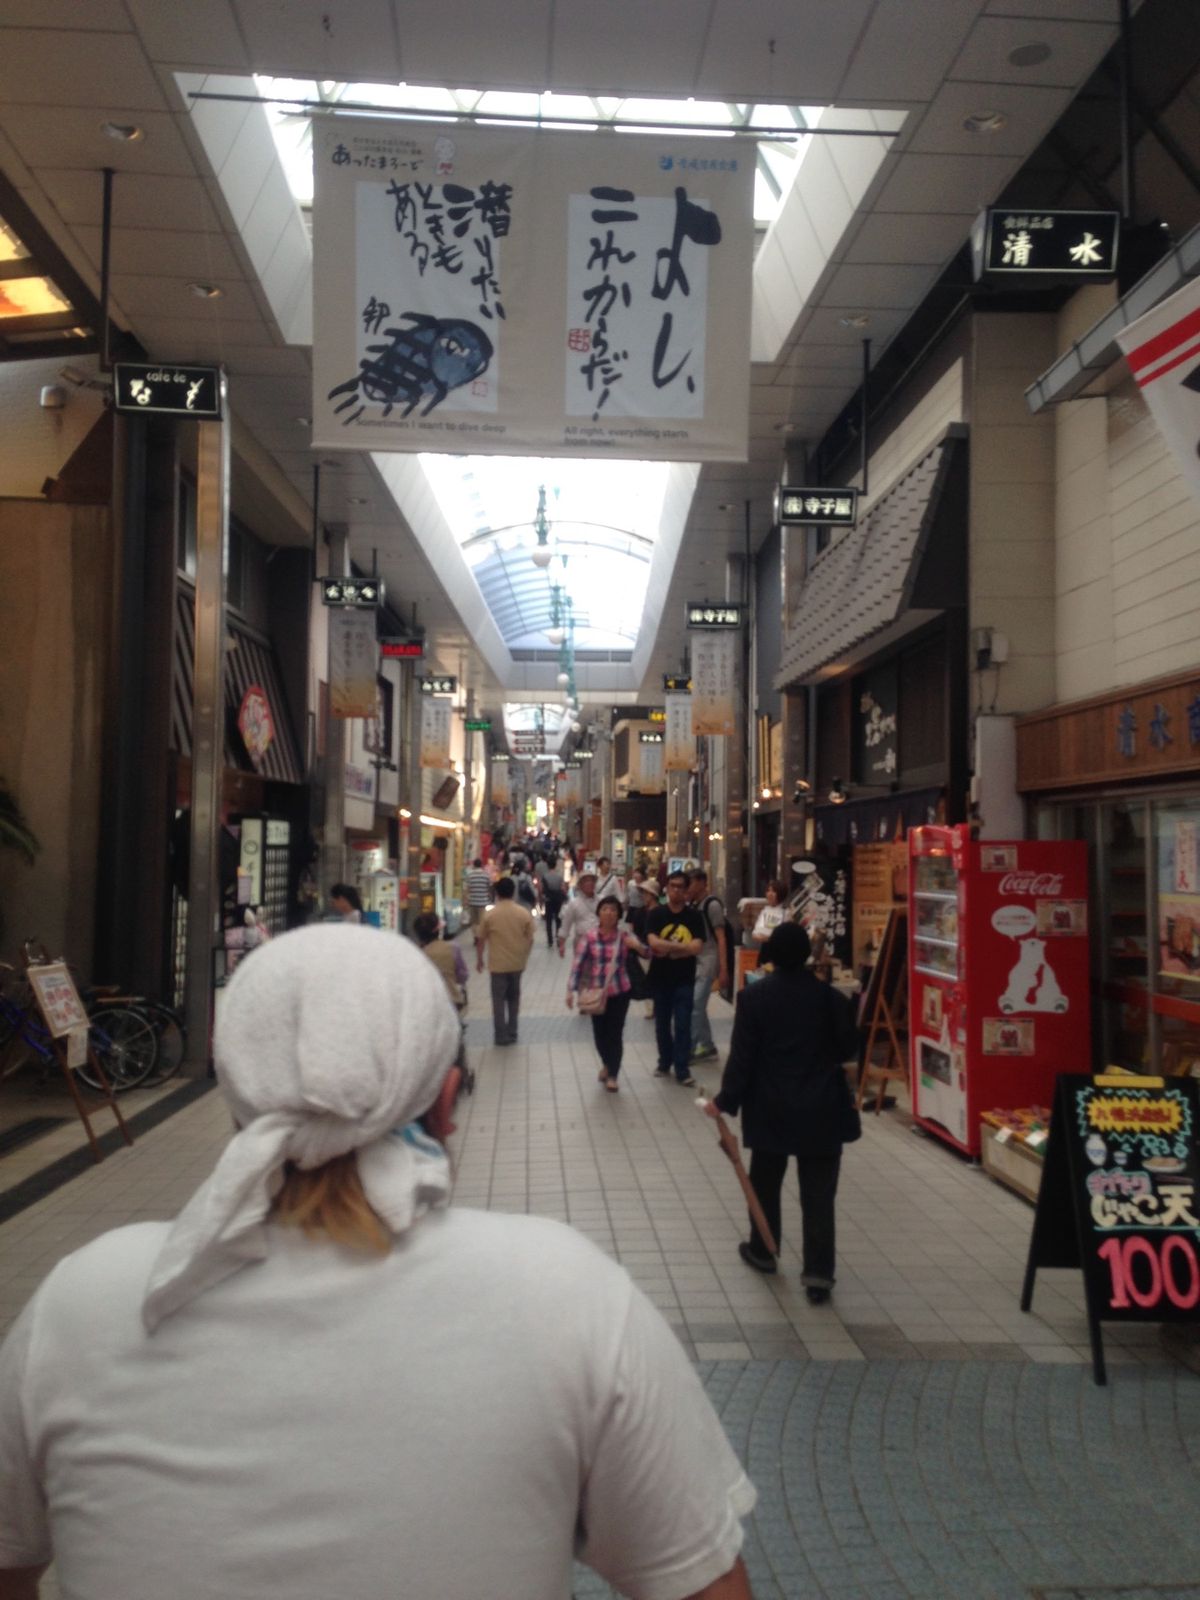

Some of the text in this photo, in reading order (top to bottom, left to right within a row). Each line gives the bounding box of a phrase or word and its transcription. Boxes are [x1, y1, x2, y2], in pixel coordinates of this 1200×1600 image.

[385, 178, 430, 278] ある
[1001, 230, 1104, 267] 清水
[445, 422, 457, 431] to
[1097, 1235, 1200, 1310] 100
